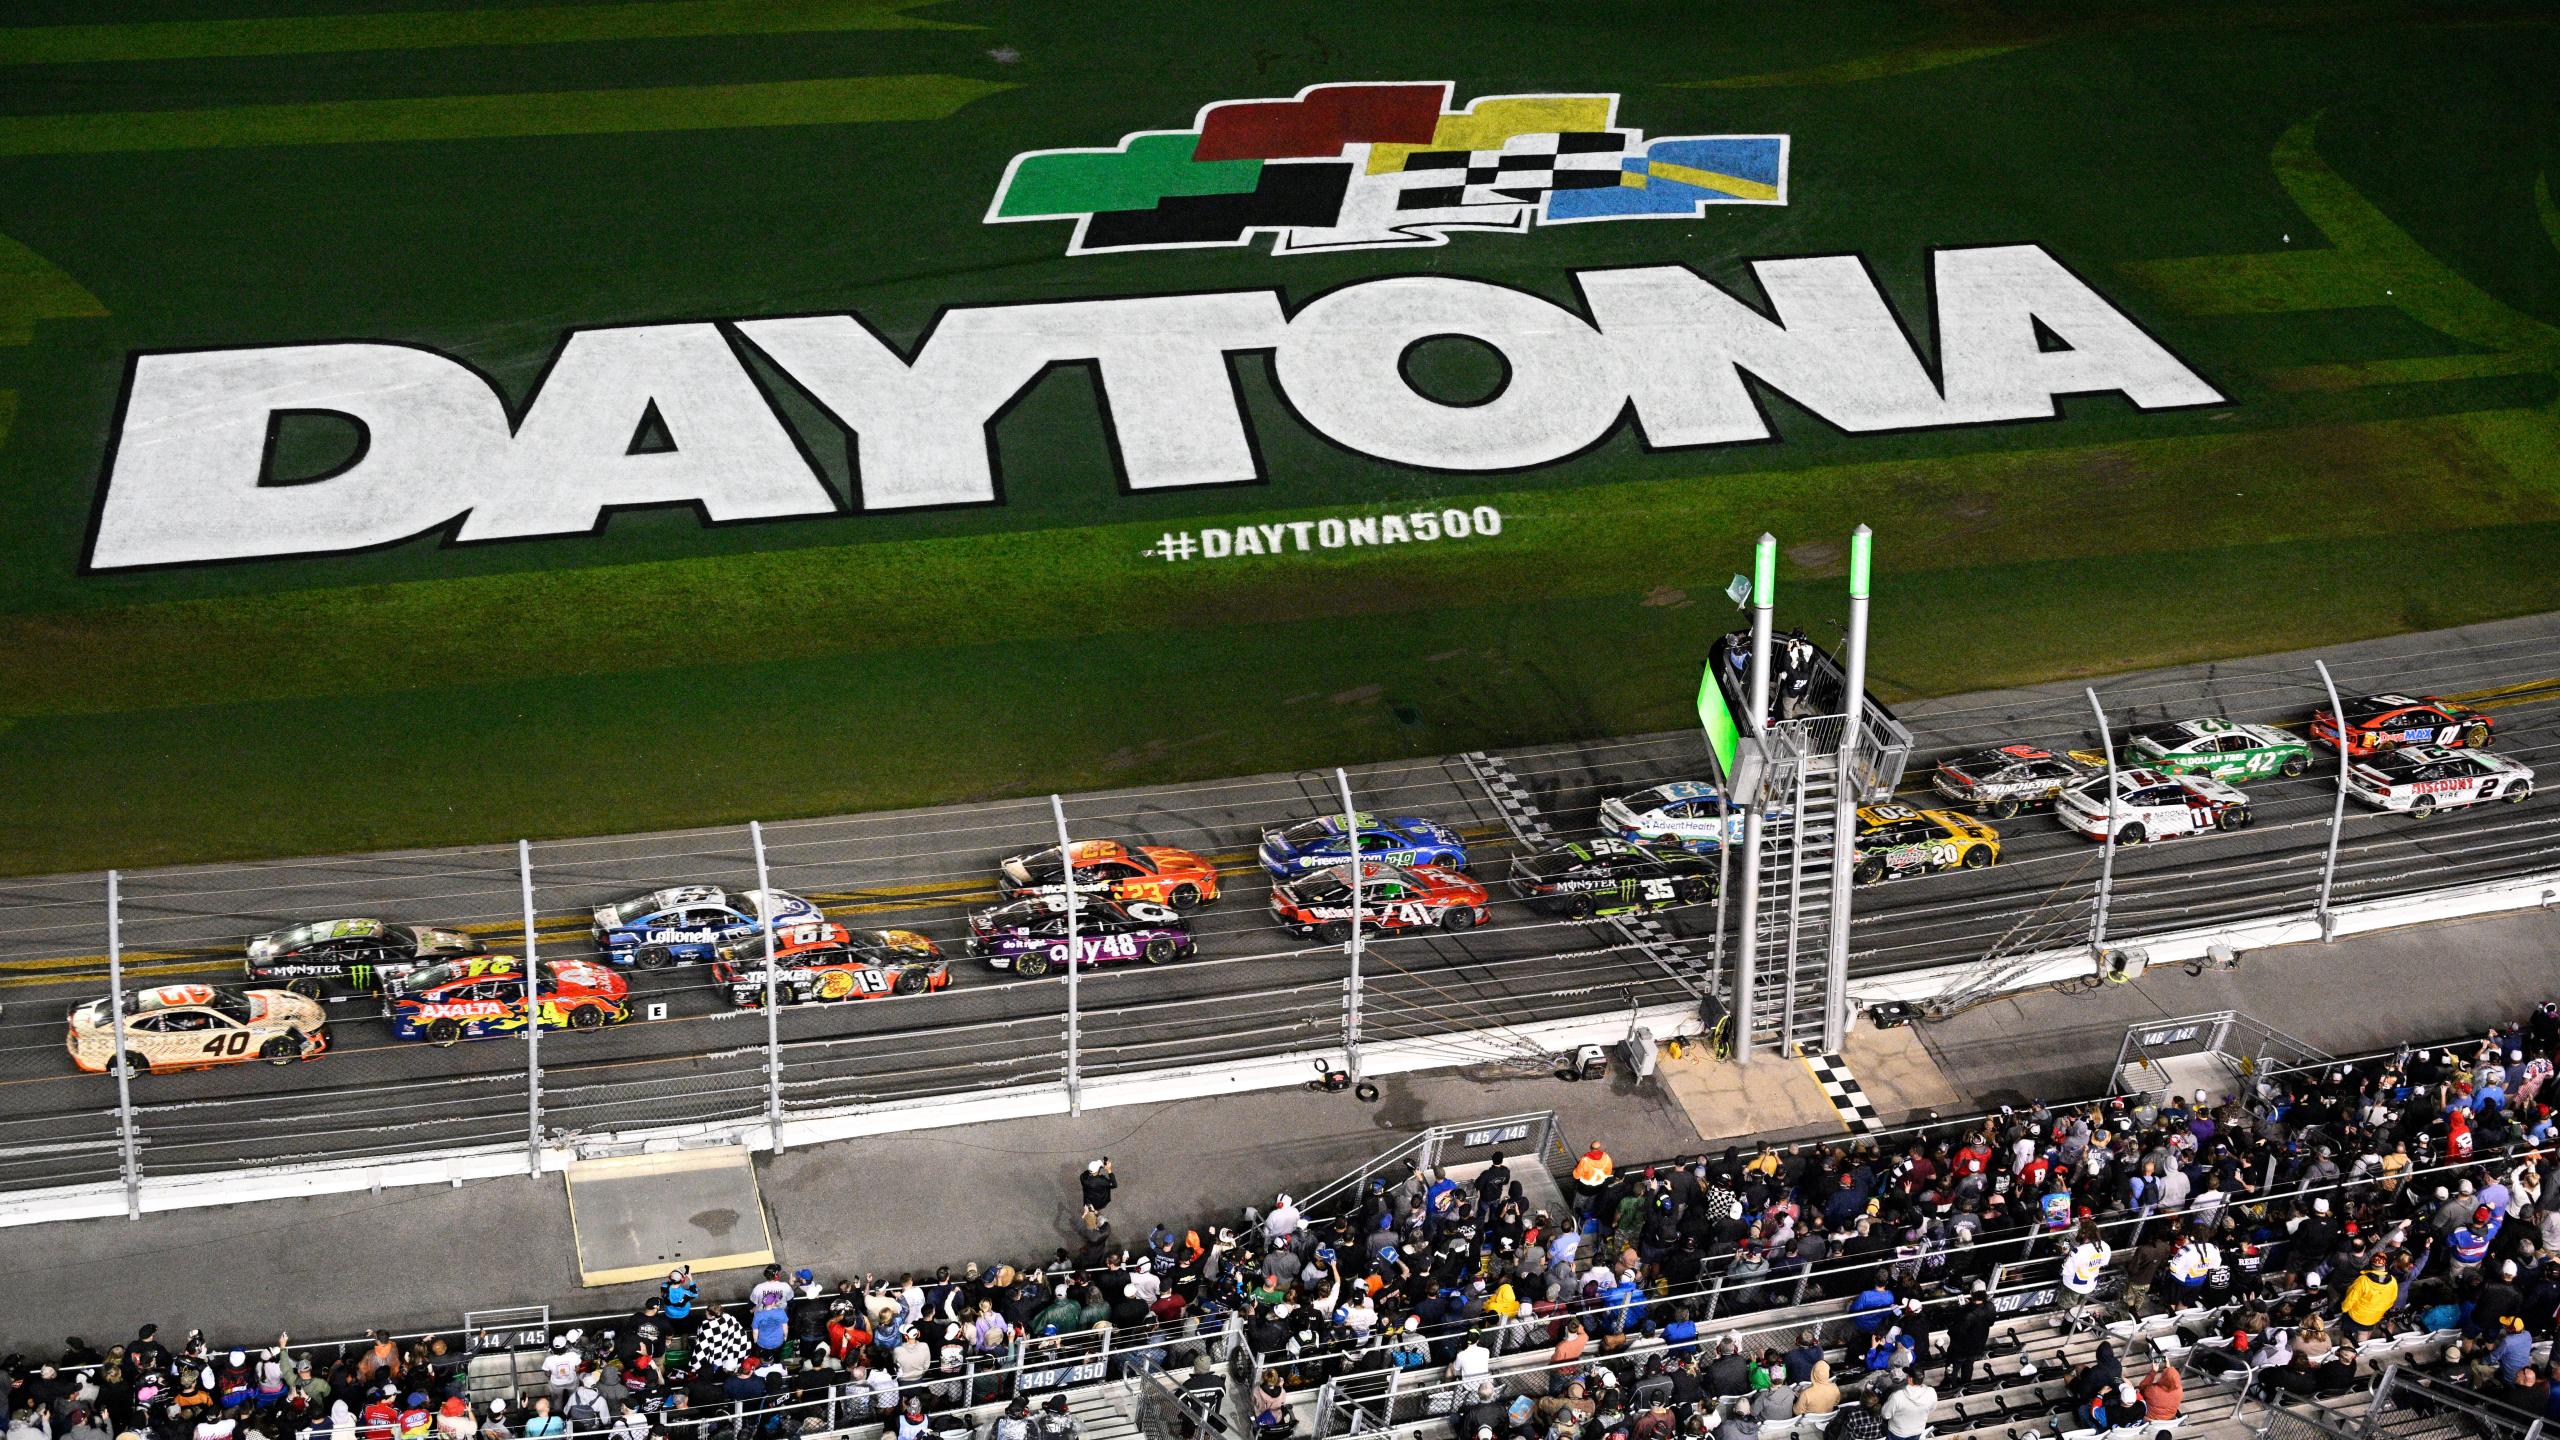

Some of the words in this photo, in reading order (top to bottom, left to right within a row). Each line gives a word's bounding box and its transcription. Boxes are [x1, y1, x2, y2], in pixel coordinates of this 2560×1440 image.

[90, 243, 2227, 570] DAYTONA
[1155, 506, 1502, 562] #DAYTONA500
[2436, 725, 2461, 745] 01
[2188, 755, 2223, 765] DOLLAR
[2224, 753, 2247, 762] TREE
[2246, 752, 2277, 773] 42
[1986, 778, 2062, 794] WINCHESTER
[2412, 777, 2474, 795] DISCOUNT
[2475, 778, 2499, 799] 2
[2191, 807, 2214, 826] 11
[1311, 854, 1382, 867] Freewacom
[1931, 843, 1958, 866] 20
[1042, 881, 1110, 894] McDnald's
[1126, 883, 1164, 903] 23
[1640, 878, 1676, 900] 35
[1400, 903, 1434, 926] 41
[646, 927, 720, 943] Cottonelle
[1003, 940, 1016, 949] do
[1050, 936, 1100, 965] aly
[1104, 933, 1137, 957] 48
[274, 964, 343, 977] MONSTER
[747, 969, 813, 984] TRCKER
[732, 983, 762, 992] BOATS
[854, 970, 887, 993] 19
[420, 1002, 502, 1019] AXALTA
[202, 1031, 251, 1057] 40
[2144, 1031, 2165, 1046] 146
[1468, 1131, 1490, 1146] 145
[1504, 1124, 1527, 1140] 146
[2034, 1289, 2058, 1306] 35
[519, 1330, 545, 1346] 145
[1023, 1370, 1055, 1389] 349
[1073, 1363, 1105, 1381] 350
